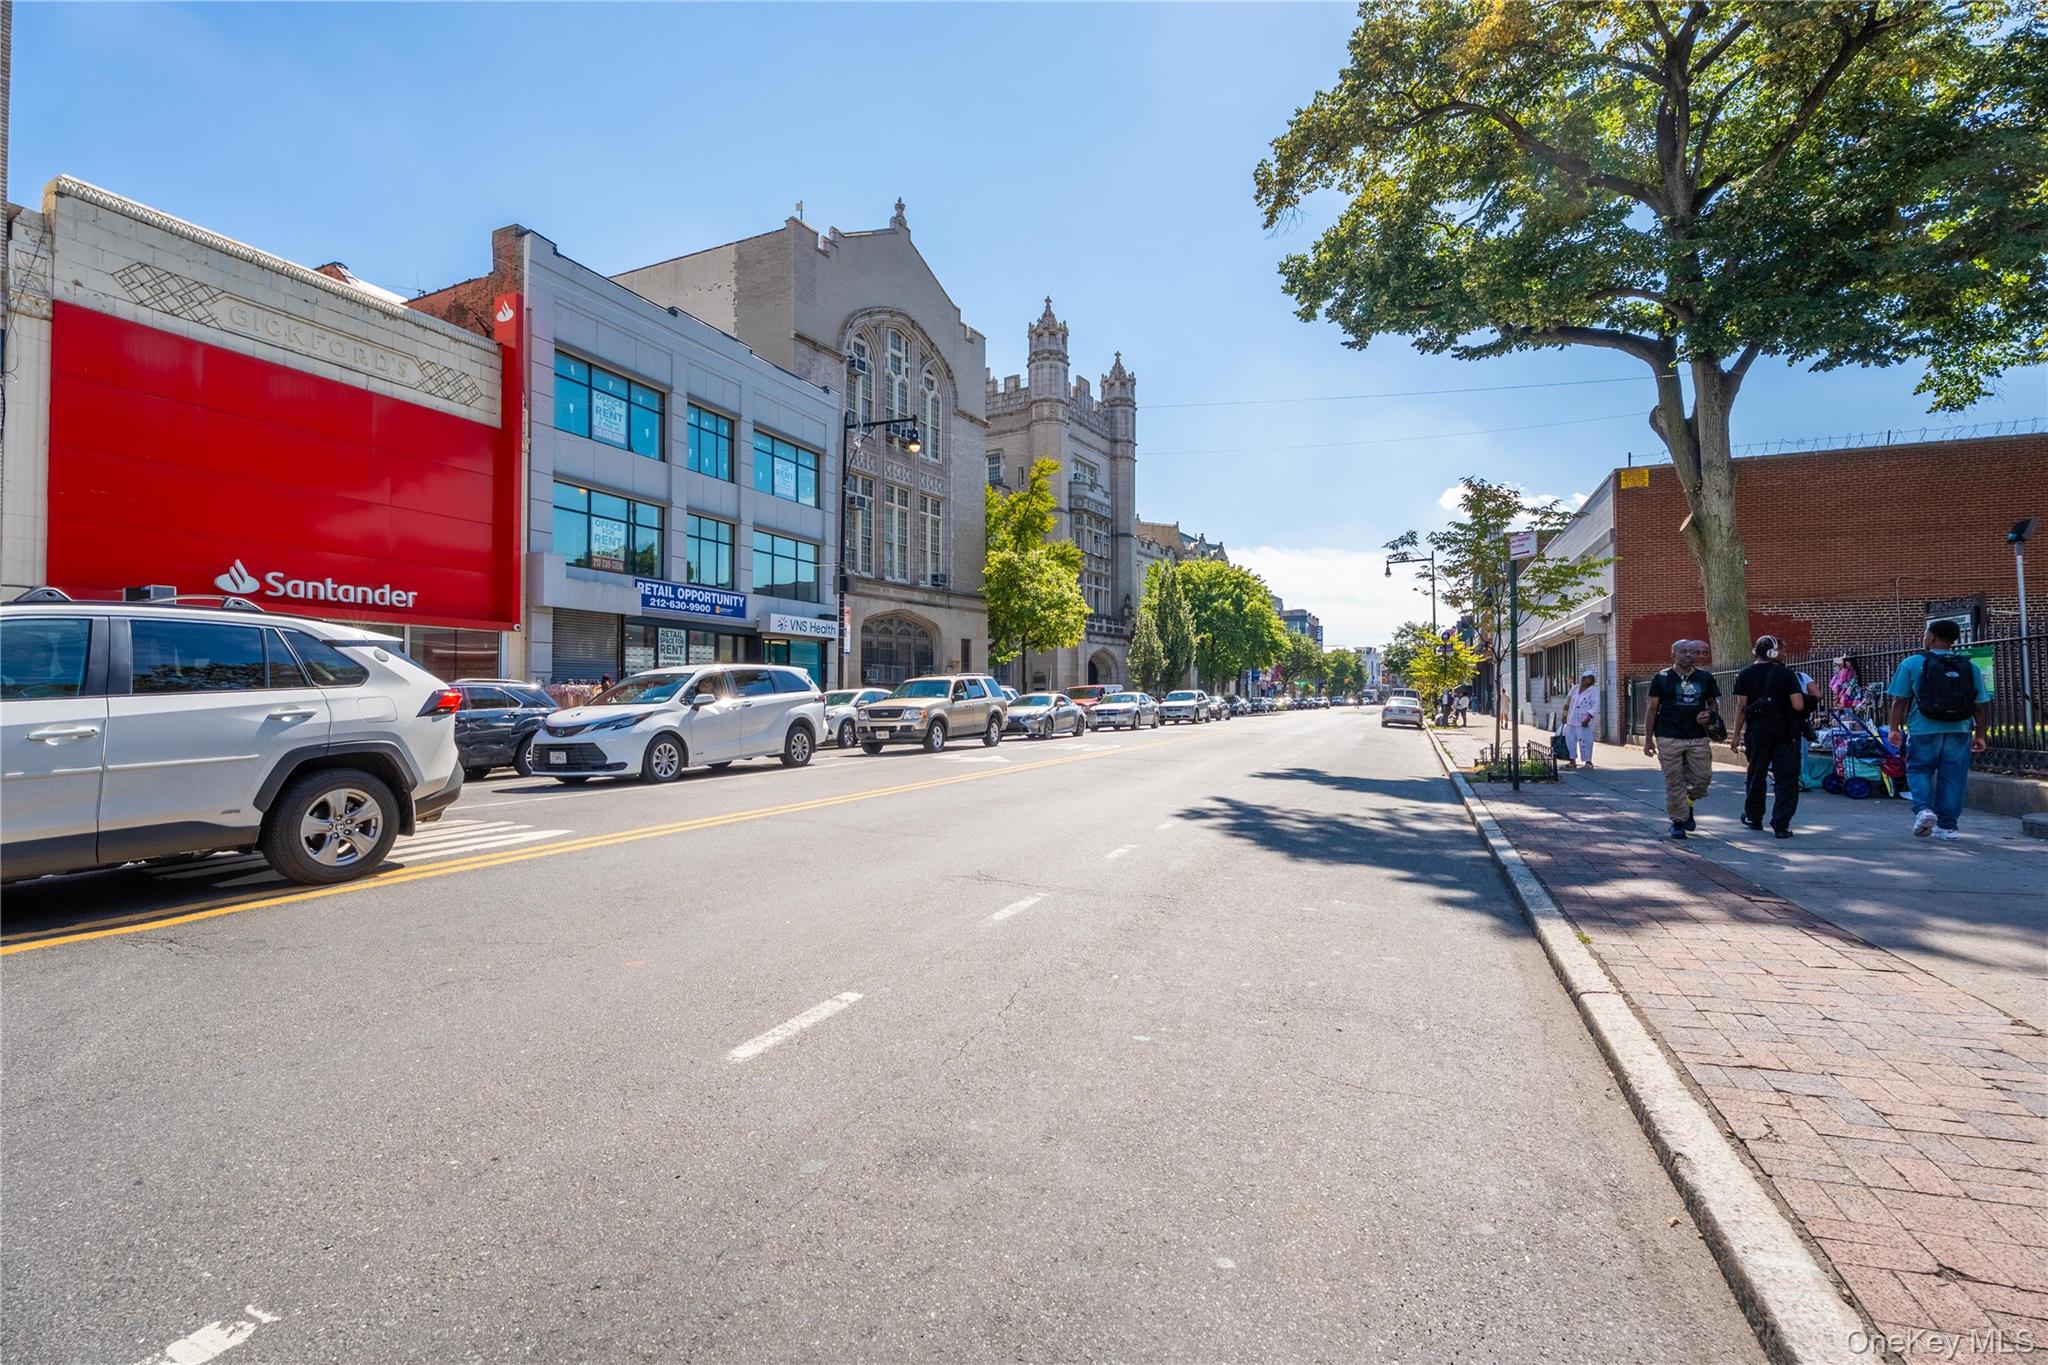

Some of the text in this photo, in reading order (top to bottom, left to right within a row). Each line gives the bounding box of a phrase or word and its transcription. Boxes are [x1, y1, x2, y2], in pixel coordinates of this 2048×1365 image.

[595, 406, 623, 422] RENT
[595, 519, 622, 532] OFFICE
[602, 528, 615, 537] FOR
[595, 534, 623, 546] RENT
[265, 571, 418, 608] Santander
[637, 582, 745, 608] RETAIL OPPORTUNITY
[649, 598, 711, 613] 212-630-9900
[661, 630, 684, 639] RETAIL
[790, 619, 836, 636] VNS Health
[660, 644, 684, 656] RENT
